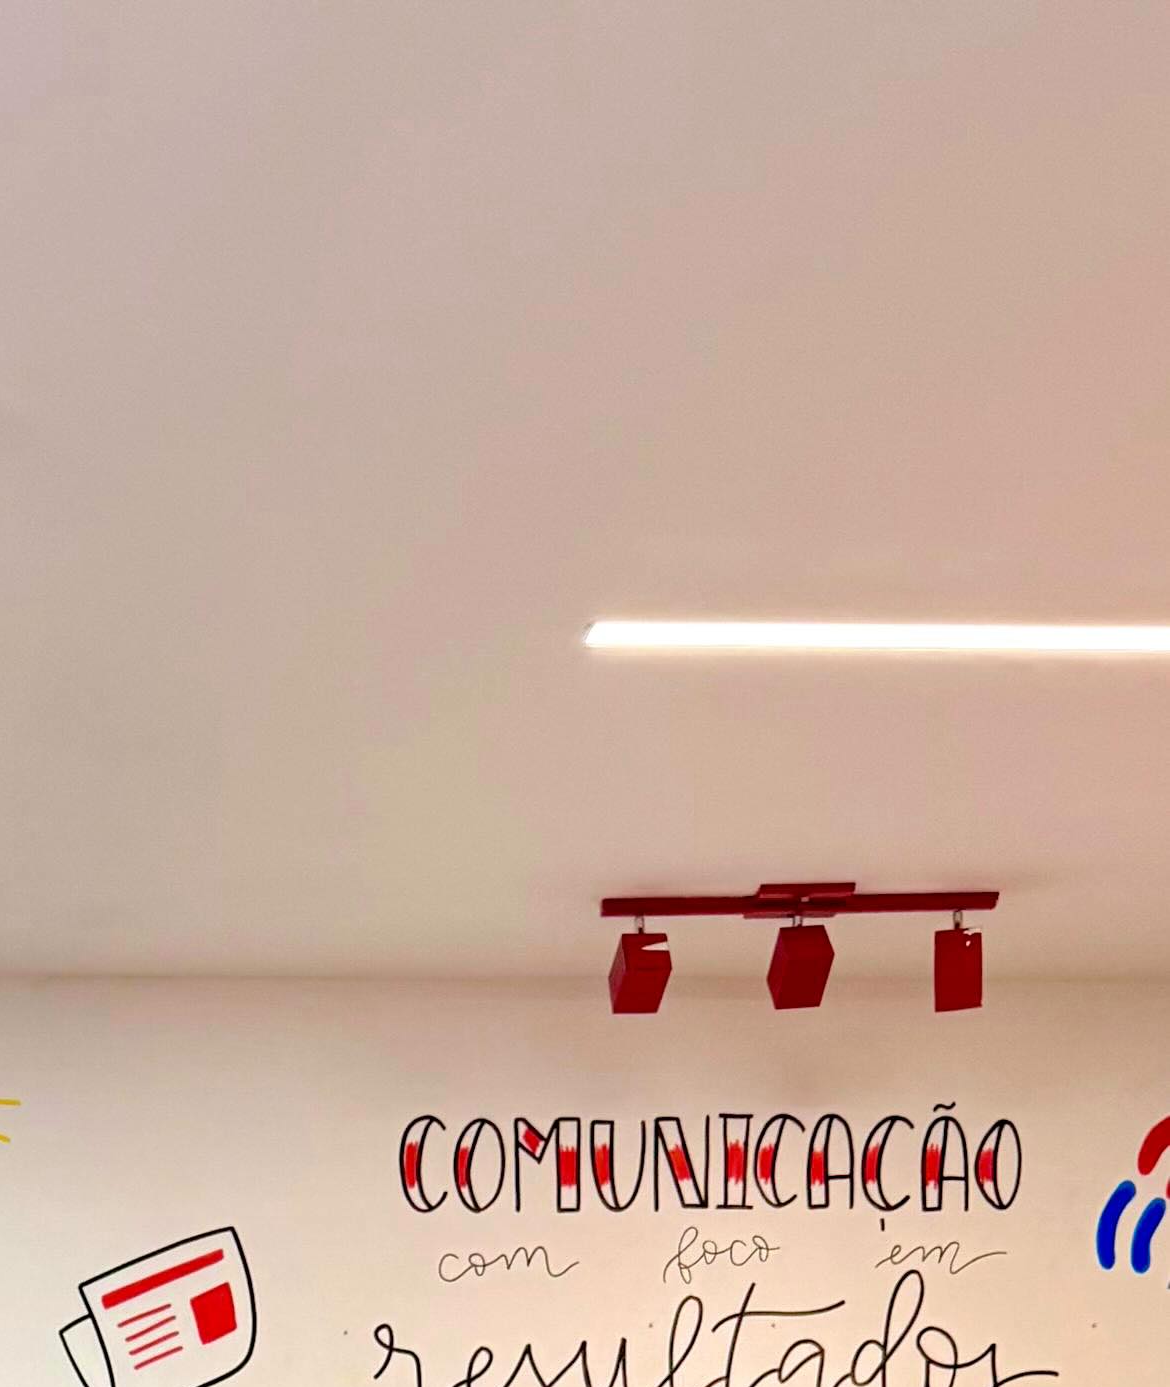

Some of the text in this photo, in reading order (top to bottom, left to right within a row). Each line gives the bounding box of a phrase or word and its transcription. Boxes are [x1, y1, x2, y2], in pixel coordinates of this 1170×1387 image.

[399, 1101, 1023, 1231] COMUNICAÇÃO
[438, 1226, 1007, 1284] com foco em
